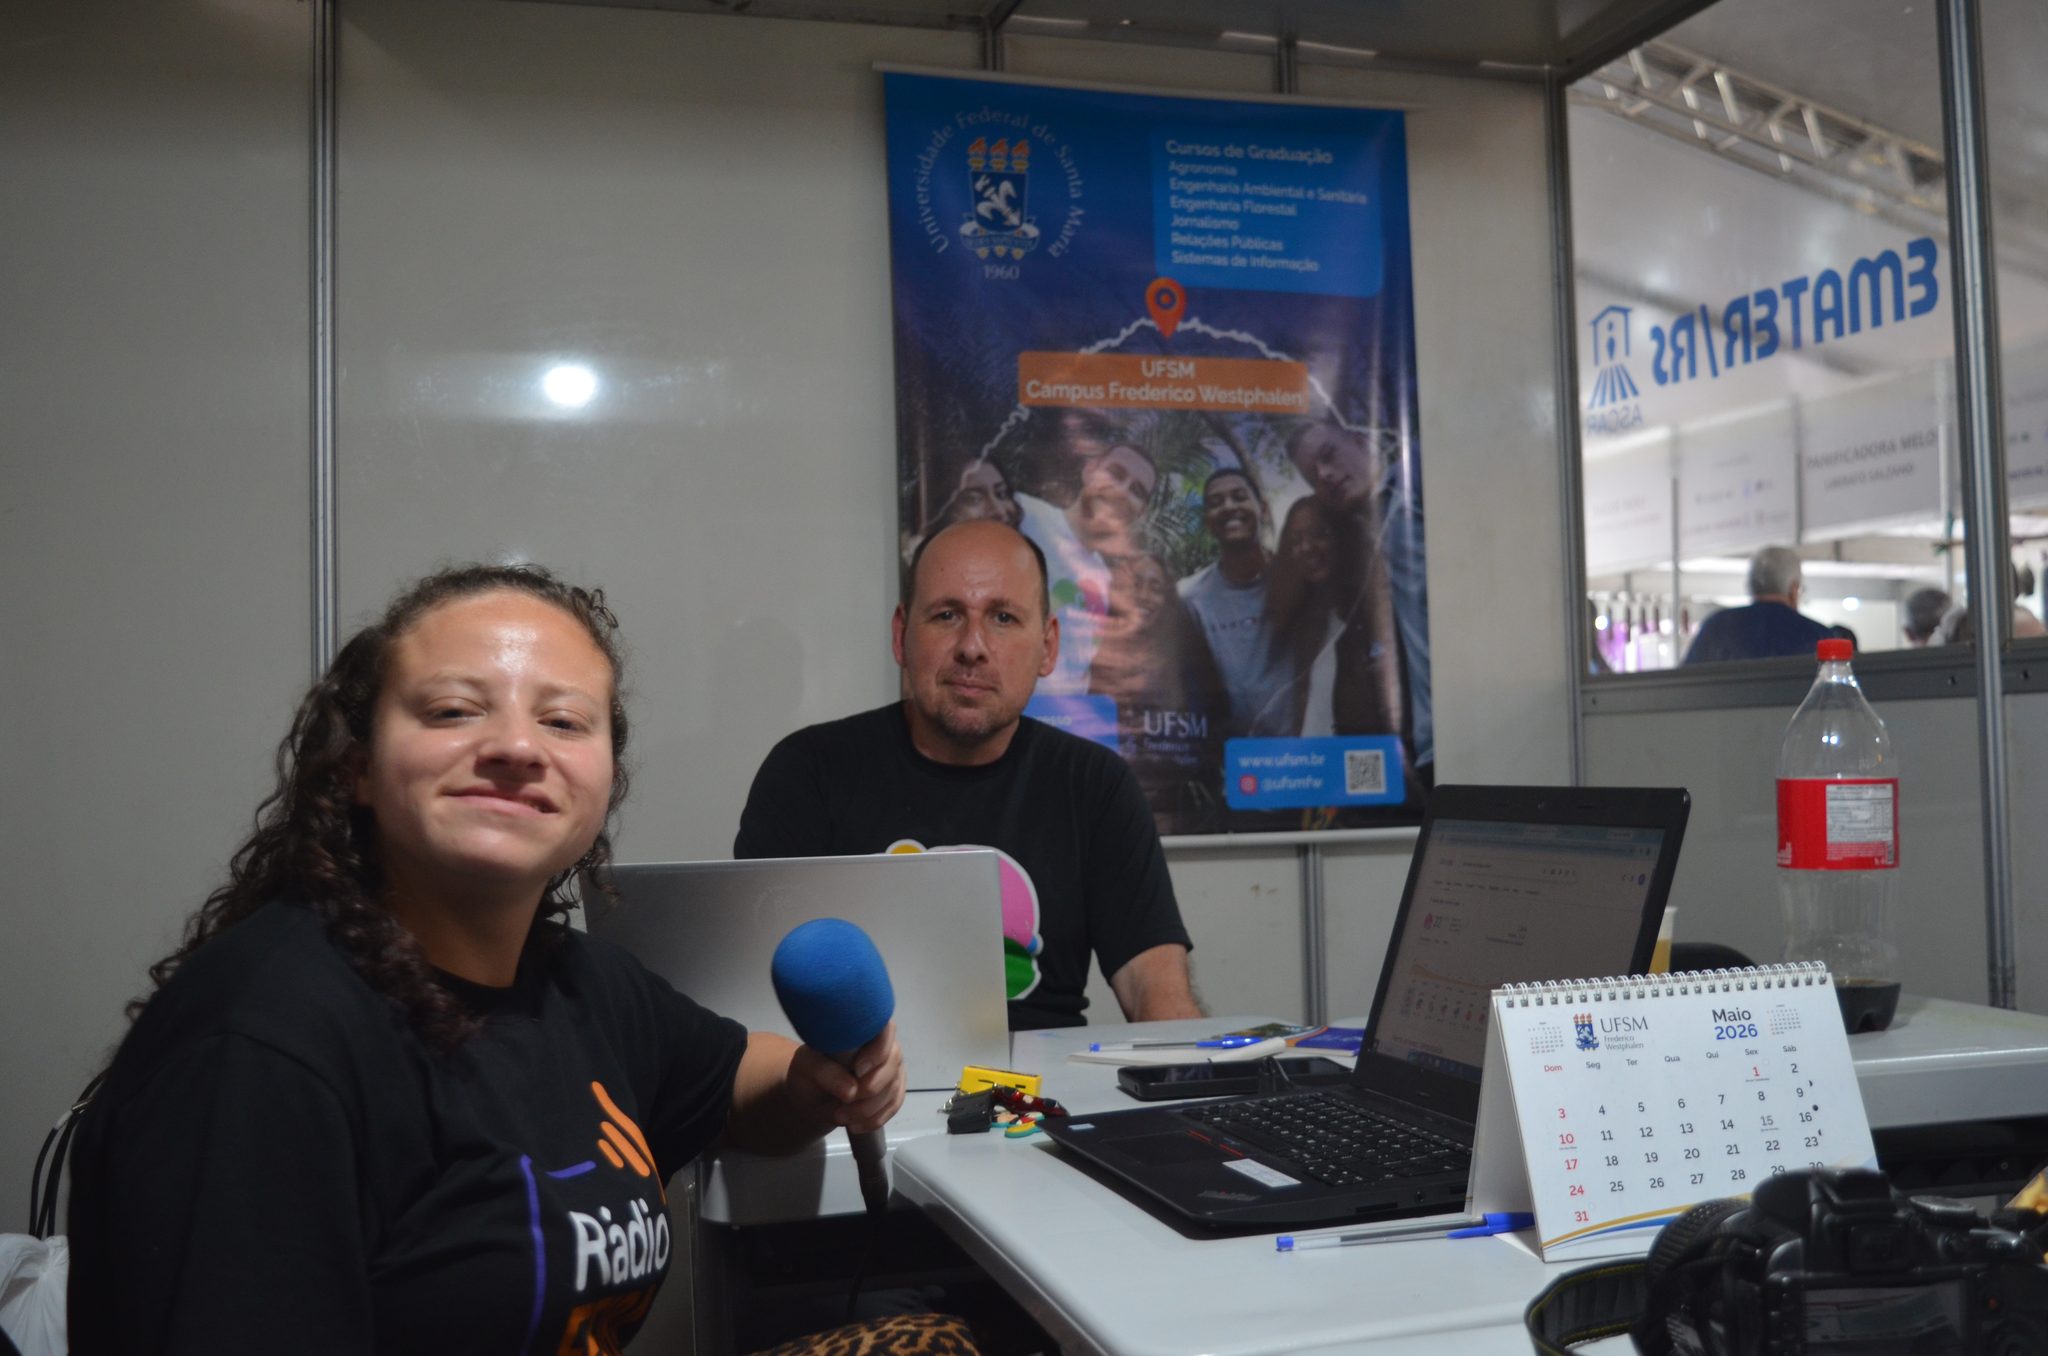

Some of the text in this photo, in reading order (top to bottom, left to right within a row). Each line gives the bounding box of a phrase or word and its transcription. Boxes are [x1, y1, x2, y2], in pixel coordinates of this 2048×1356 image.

[1165, 139, 1333, 166] Cursos de Graduação
[1168, 160, 1238, 176] Agronomia
[913, 105, 1086, 258] Universidade Federal de Santa Maria
[1169, 177, 1239, 195] Engenharia
[1243, 182, 1305, 200] Ambiental
[1169, 195, 1298, 216] Engenharia Florestal
[1171, 214, 1240, 230] Jornalismo
[1171, 231, 1284, 251] Relações Públicas
[1171, 250, 1320, 273] Sistemas de Informação
[983, 264, 1020, 280] 1960
[1141, 360, 1196, 380] UFSM
[1026, 379, 1303, 408] Campus Frederico Westphalen
[1144, 709, 1209, 738] UFSM
[1238, 752, 1326, 767] www.ufsm.br
[1600, 1015, 1649, 1034] UFSM
[1711, 1006, 1752, 1024] Maio
[1604, 1034, 1635, 1043] Frederico
[1714, 1023, 1759, 1041] 2026
[1605, 1041, 1645, 1052] Westphalen
[1543, 1064, 1563, 1073] Dom
[1585, 1060, 1601, 1071] Seg
[1625, 1058, 1639, 1067] Ter
[1664, 1055, 1681, 1064] Qua
[1705, 1050, 1719, 1060] Qui
[1744, 1048, 1760, 1057] Sex
[1752, 1062, 1799, 1077] 1 2
[1558, 1088, 1804, 1120] 3 4 5 6 7 8 9
[1559, 1112, 1813, 1145] 10 11 12 13 14 15 16
[1565, 1137, 1819, 1171] 17 18 19 20 21 22 23
[1569, 1185, 1585, 1197] 24
[1609, 1181, 1625, 1193] 25
[1649, 1177, 1665, 1189] 26
[1689, 1173, 1705, 1185] 27
[1730, 1169, 1746, 1181] 28
[1574, 1211, 1589, 1223] 31
